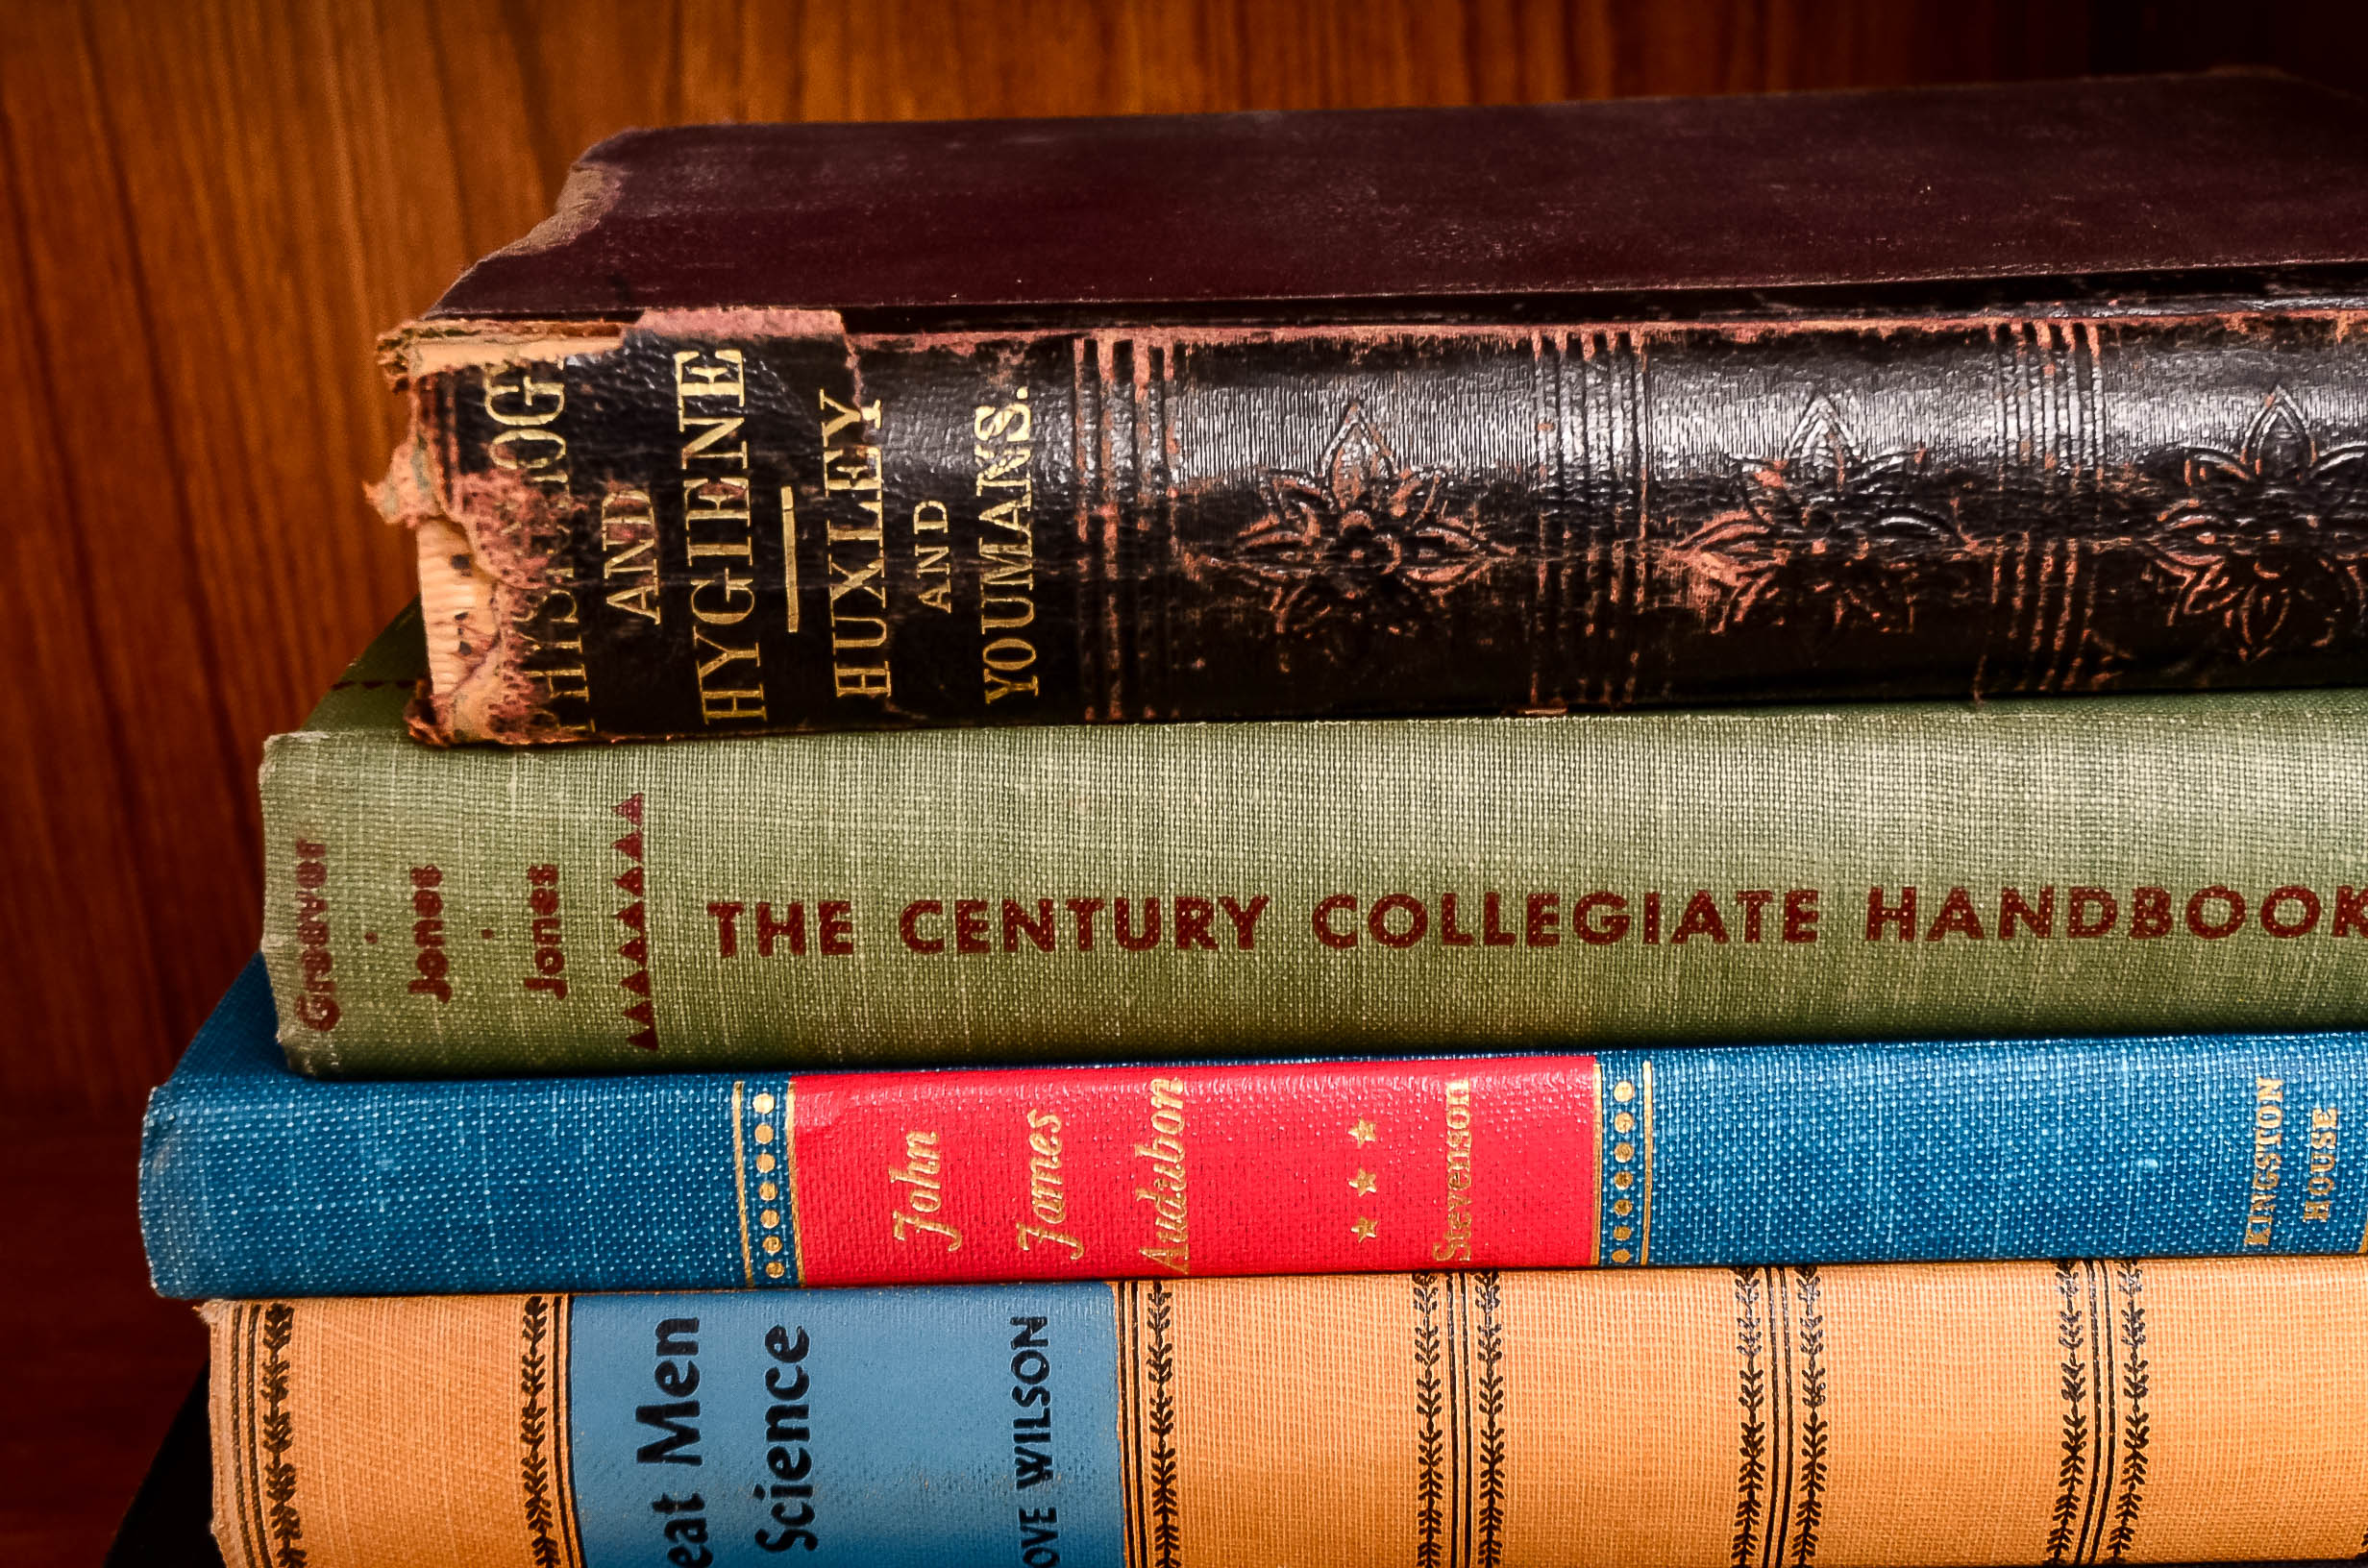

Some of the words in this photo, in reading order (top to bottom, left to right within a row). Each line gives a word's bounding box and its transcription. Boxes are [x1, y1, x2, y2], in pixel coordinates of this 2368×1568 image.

[603, 488, 662, 625] AND
[675, 348, 769, 725] HYGIENE
[820, 389, 891, 698] HUXLEY
[913, 500, 953, 614] AND
[974, 387, 1039, 705] YOUMANS.
[408, 864, 453, 1004] Jones
[525, 864, 568, 1000] Jones
[706, 899, 854, 959] THE
[898, 894, 1270, 955] CENTURY
[1311, 889, 1820, 950] COLLEGIATE
[890, 1129, 962, 1253] John
[1016, 1108, 1085, 1261] James
[1134, 1076, 1191, 1276] Audubon
[1433, 1078, 1474, 1263] Stevenson
[2243, 1076, 2285, 1248] KINGSTON
[2303, 1107, 2339, 1224] HOUSE
[635, 1315, 703, 1468] Men
[754, 1323, 819, 1555] Science
[1010, 1314, 1055, 1489] WILSON
